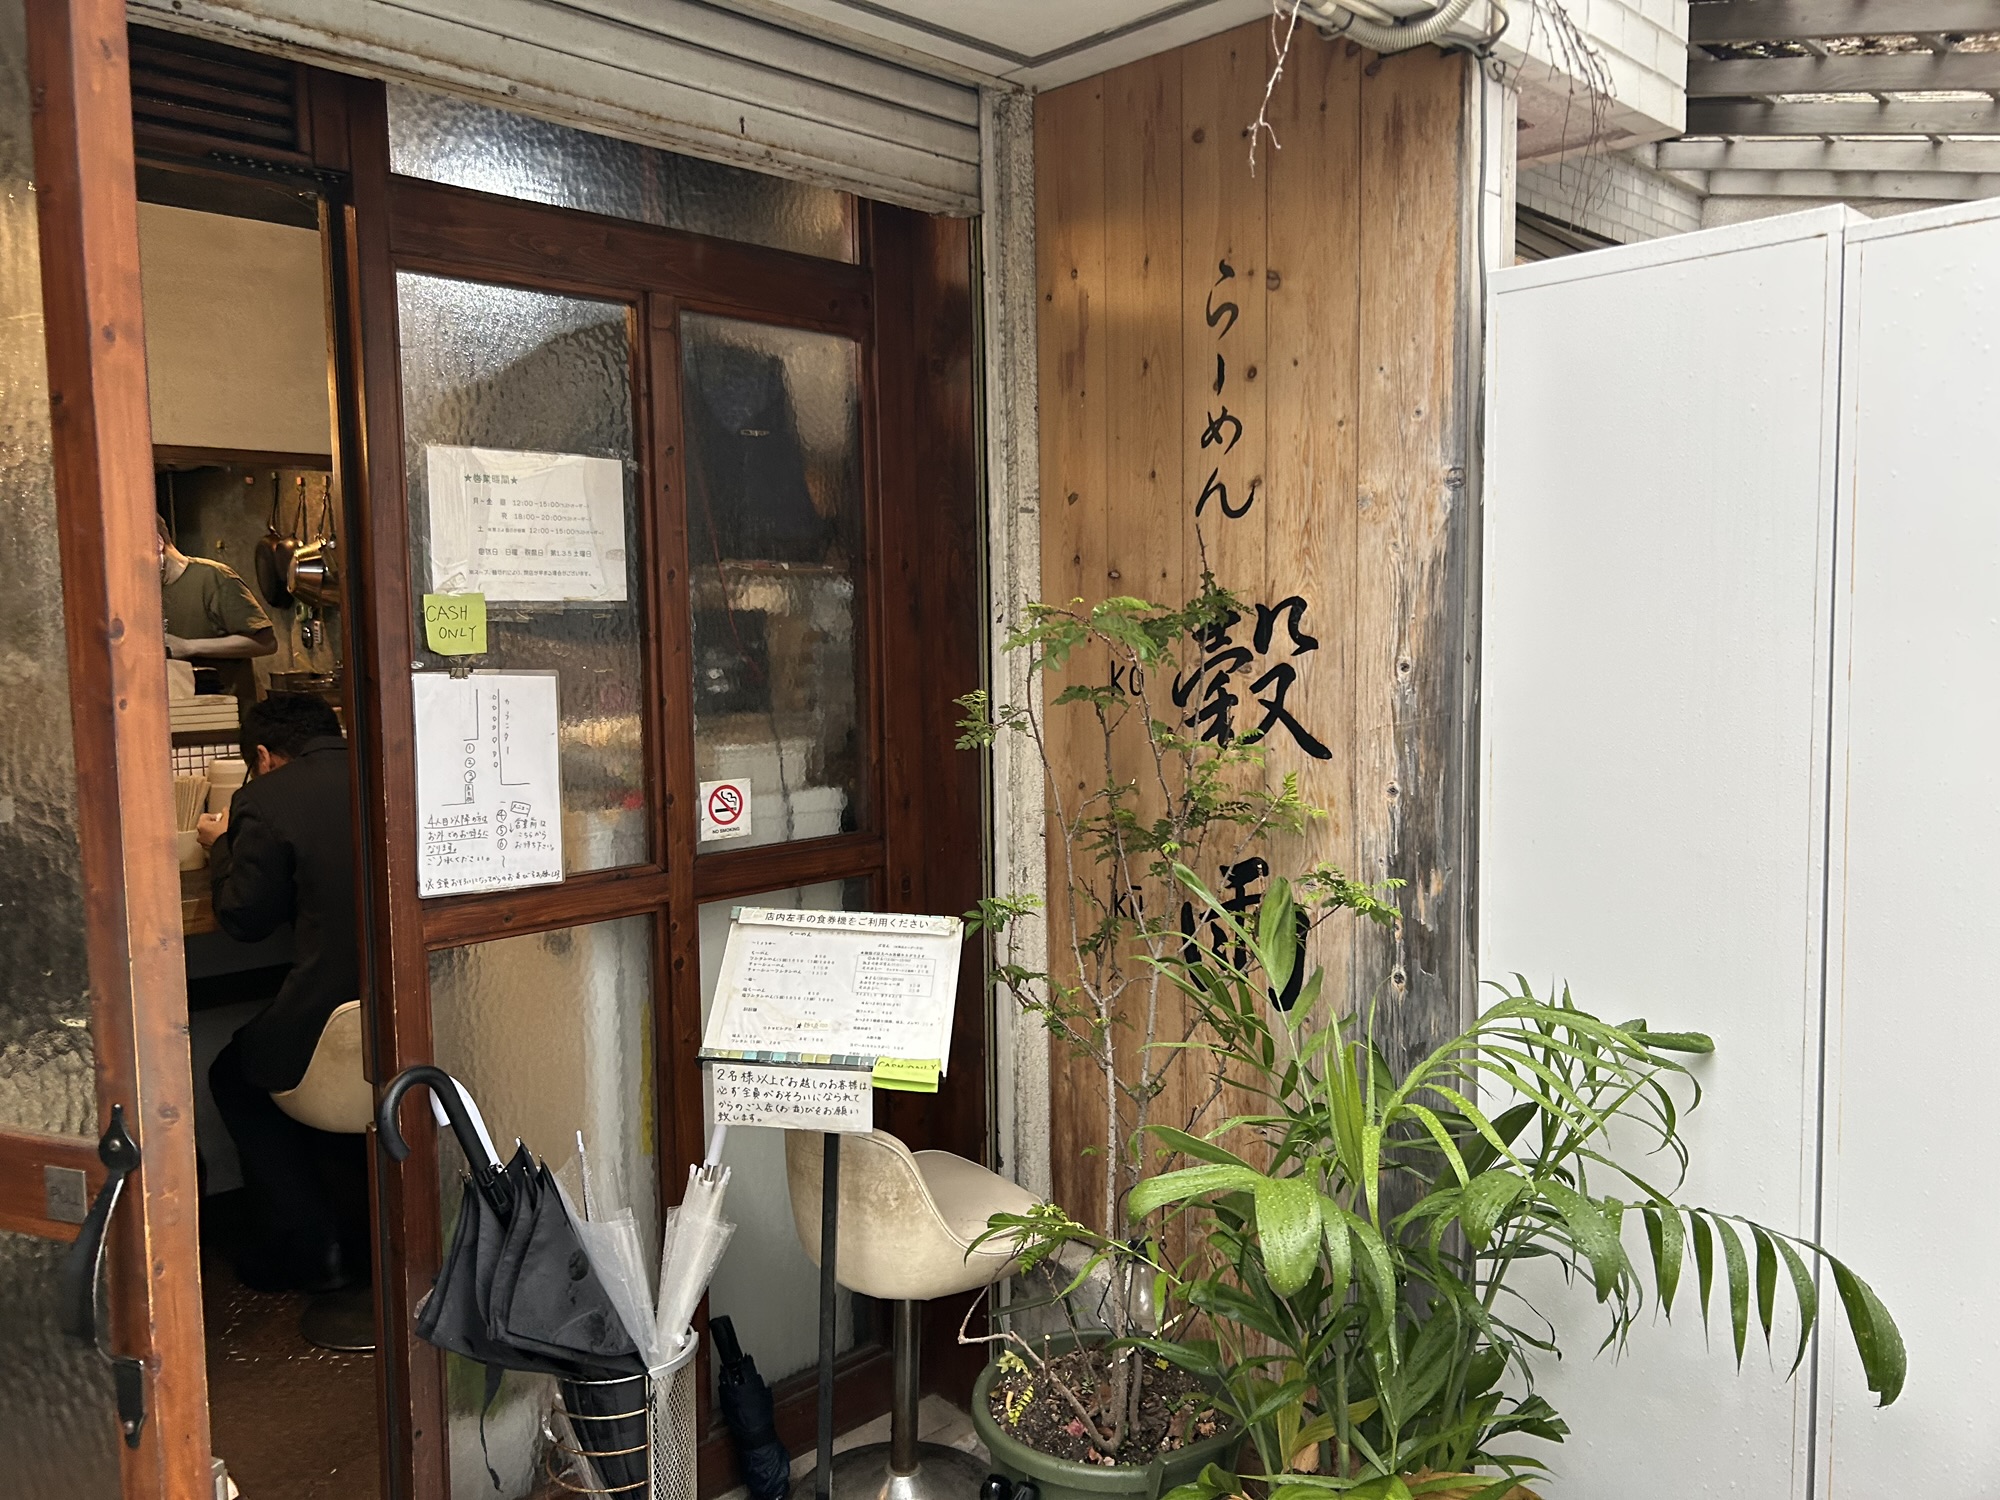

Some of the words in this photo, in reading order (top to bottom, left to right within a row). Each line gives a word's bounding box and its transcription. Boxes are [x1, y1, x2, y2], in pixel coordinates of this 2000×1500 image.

[1195, 259, 1255, 518] らーめん
[425, 604, 468, 622] CASH
[438, 625, 477, 642] ONLY
[719, 826, 741, 834] SMOKING
[764, 912, 929, 929] 店内左手の食券機をご利用ください
